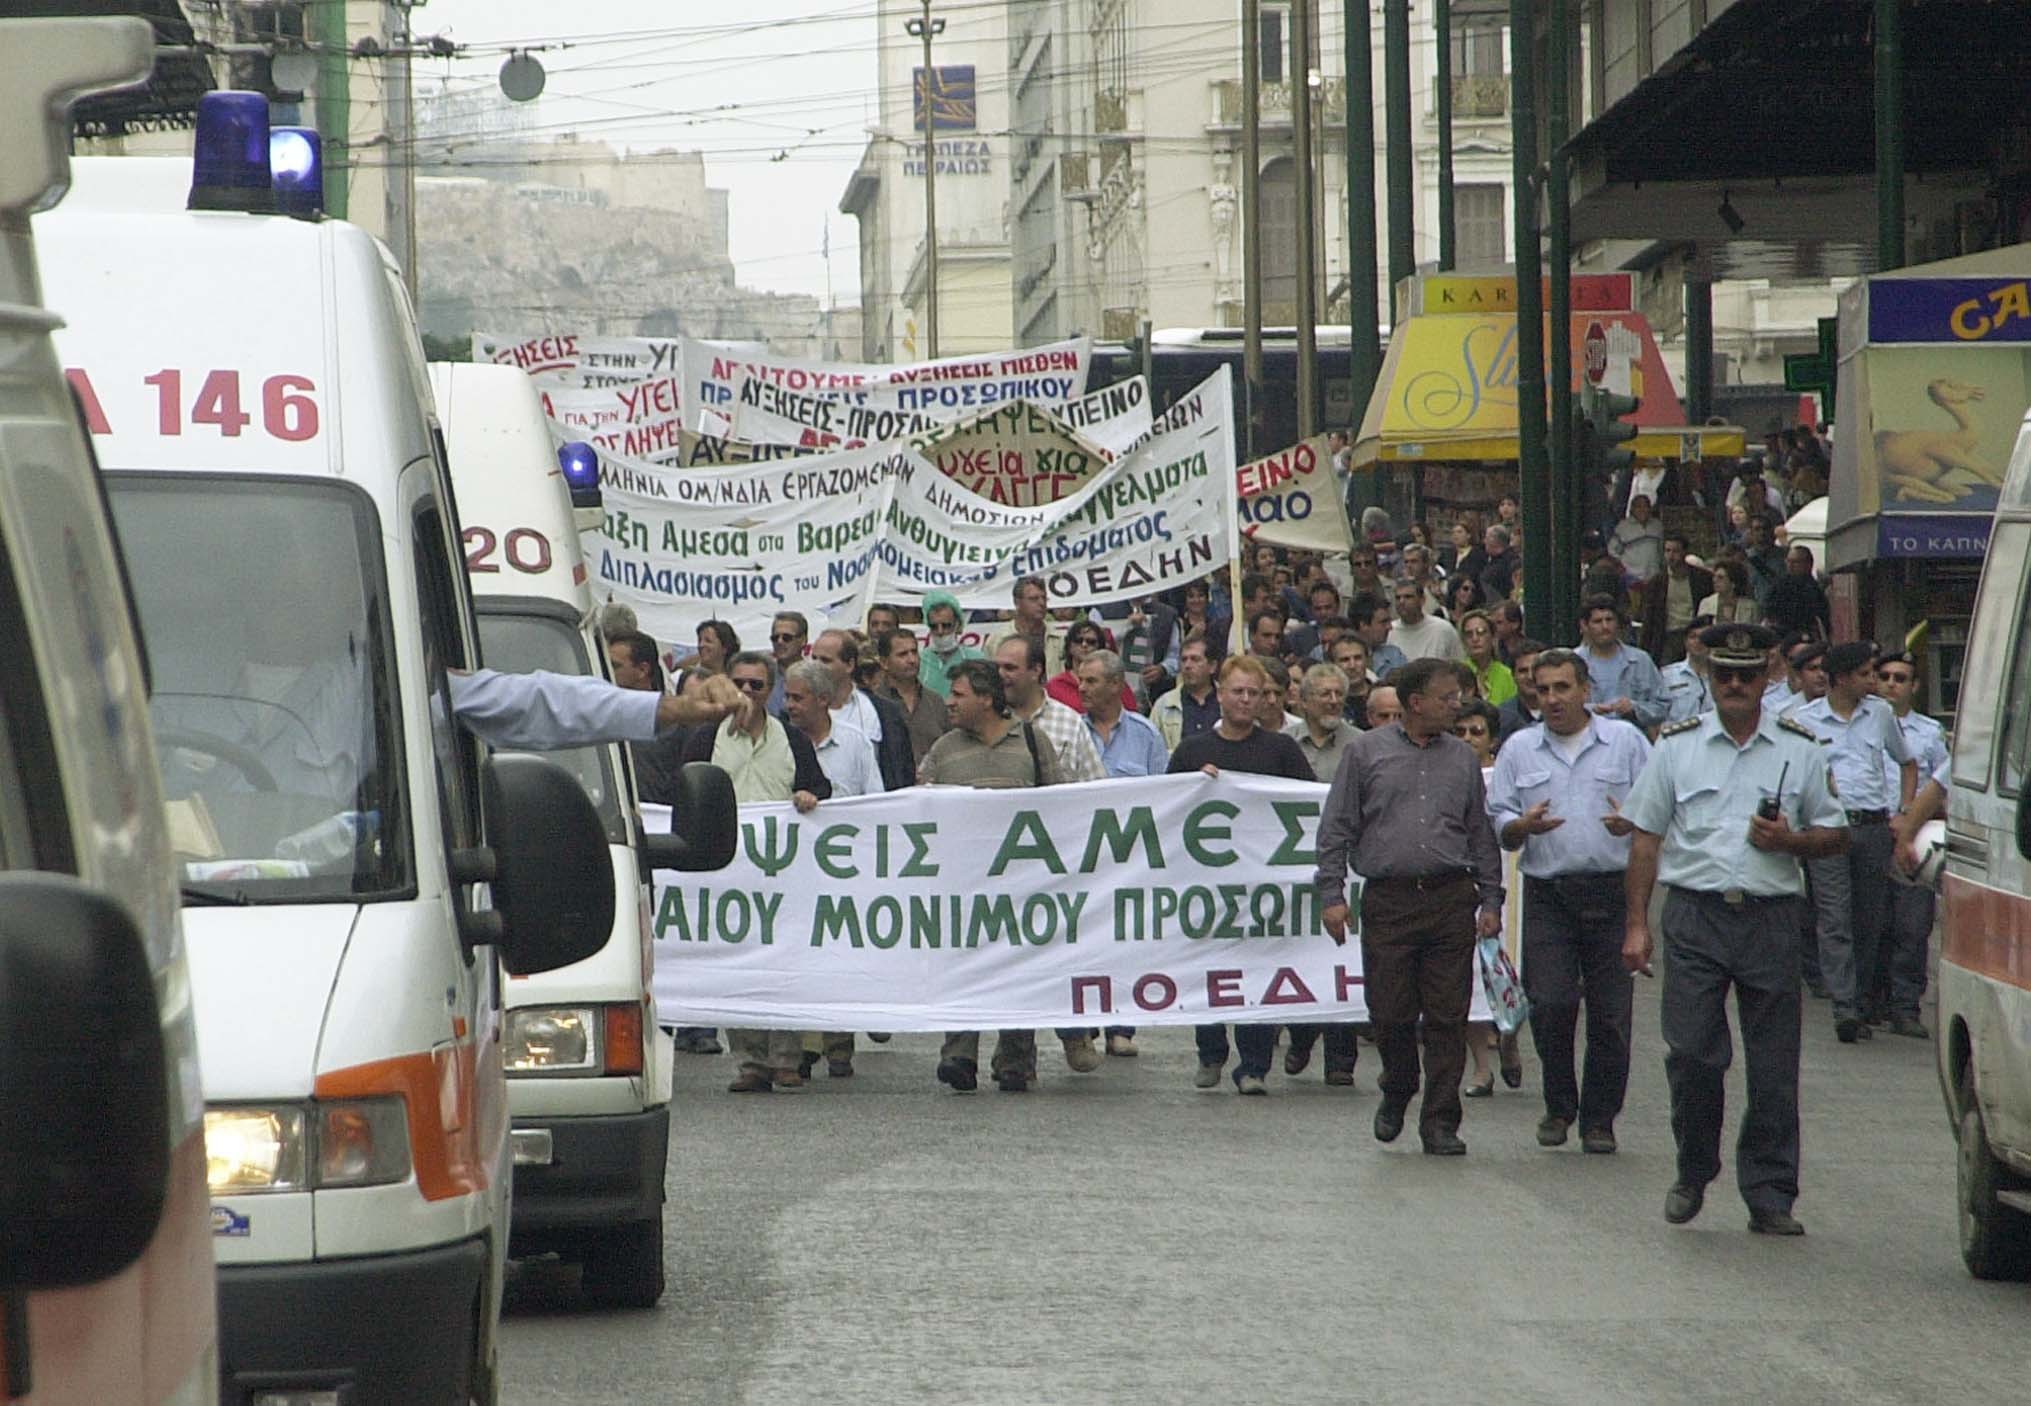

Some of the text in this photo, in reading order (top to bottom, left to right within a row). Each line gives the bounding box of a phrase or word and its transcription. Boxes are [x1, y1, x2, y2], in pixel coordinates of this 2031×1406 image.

[144, 369, 320, 442] 146
[462, 526, 552, 574] 20
[741, 800, 1320, 879] ΨΕΙΣ ΑΜΕΣ
[655, 886, 784, 944] ΑΙΟΥ
[810, 880, 1088, 949] ΜΟΝΙΜΟΥ
